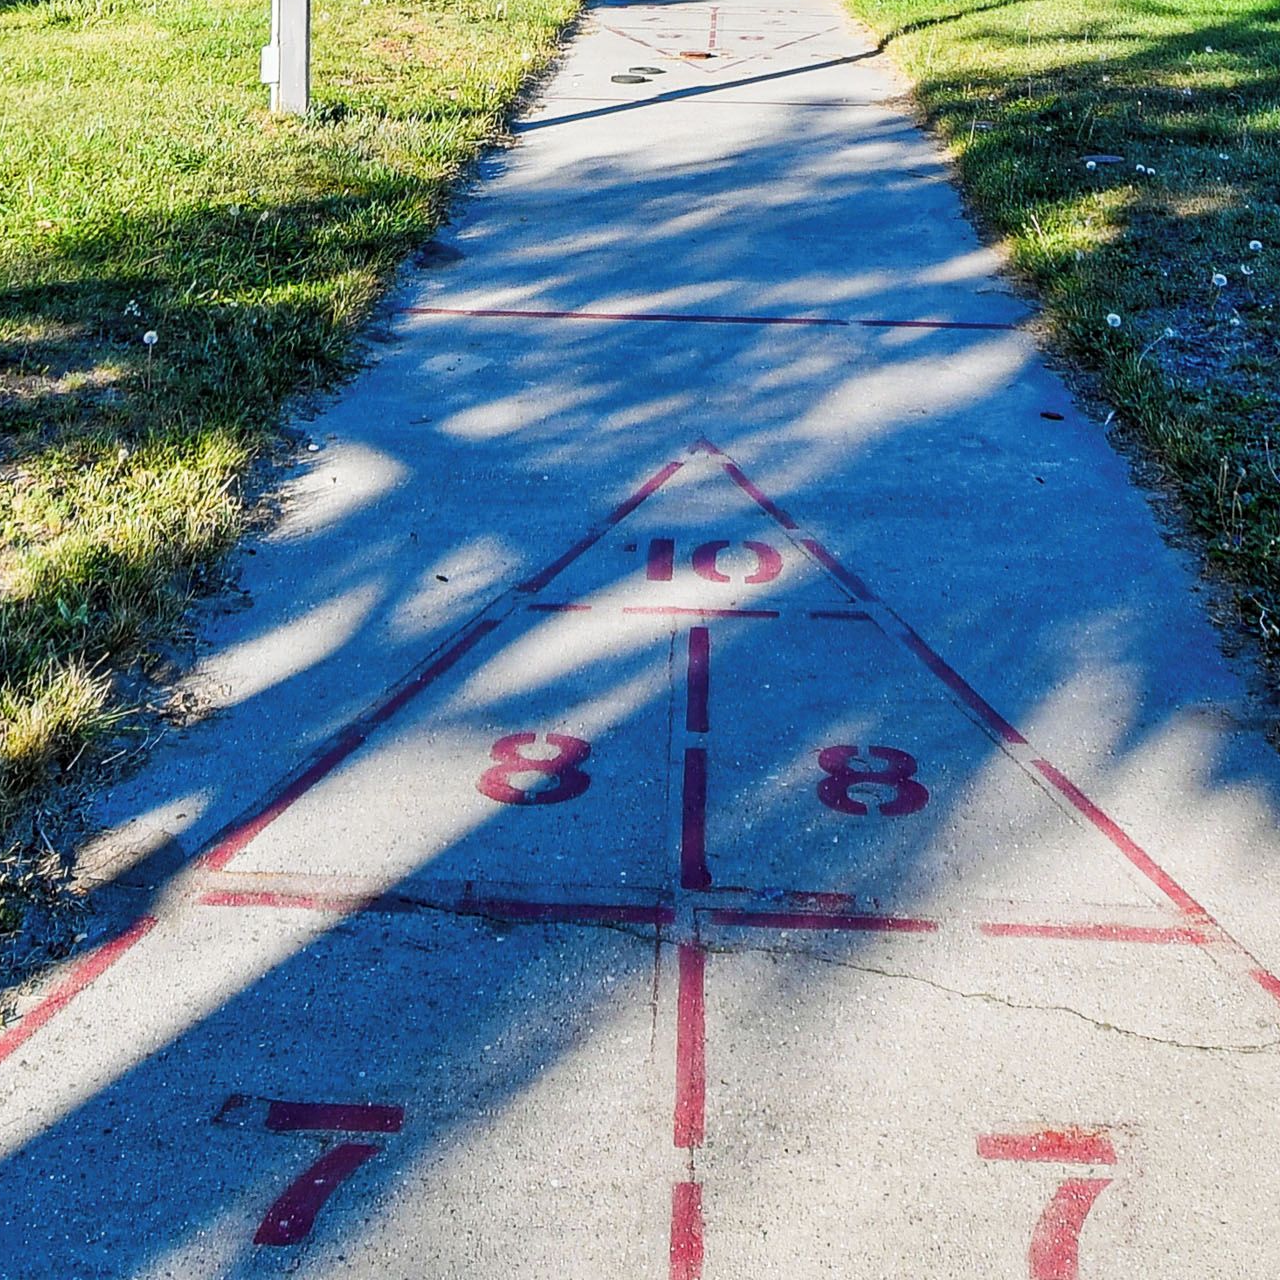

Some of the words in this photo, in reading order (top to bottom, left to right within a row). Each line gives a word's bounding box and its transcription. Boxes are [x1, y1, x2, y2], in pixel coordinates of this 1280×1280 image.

[625, 538, 784, 584] 10
[477, 732, 592, 805] 8
[816, 745, 930, 816] 8
[251, 1100, 404, 1247] 7
[976, 1128, 1117, 1280] 7
